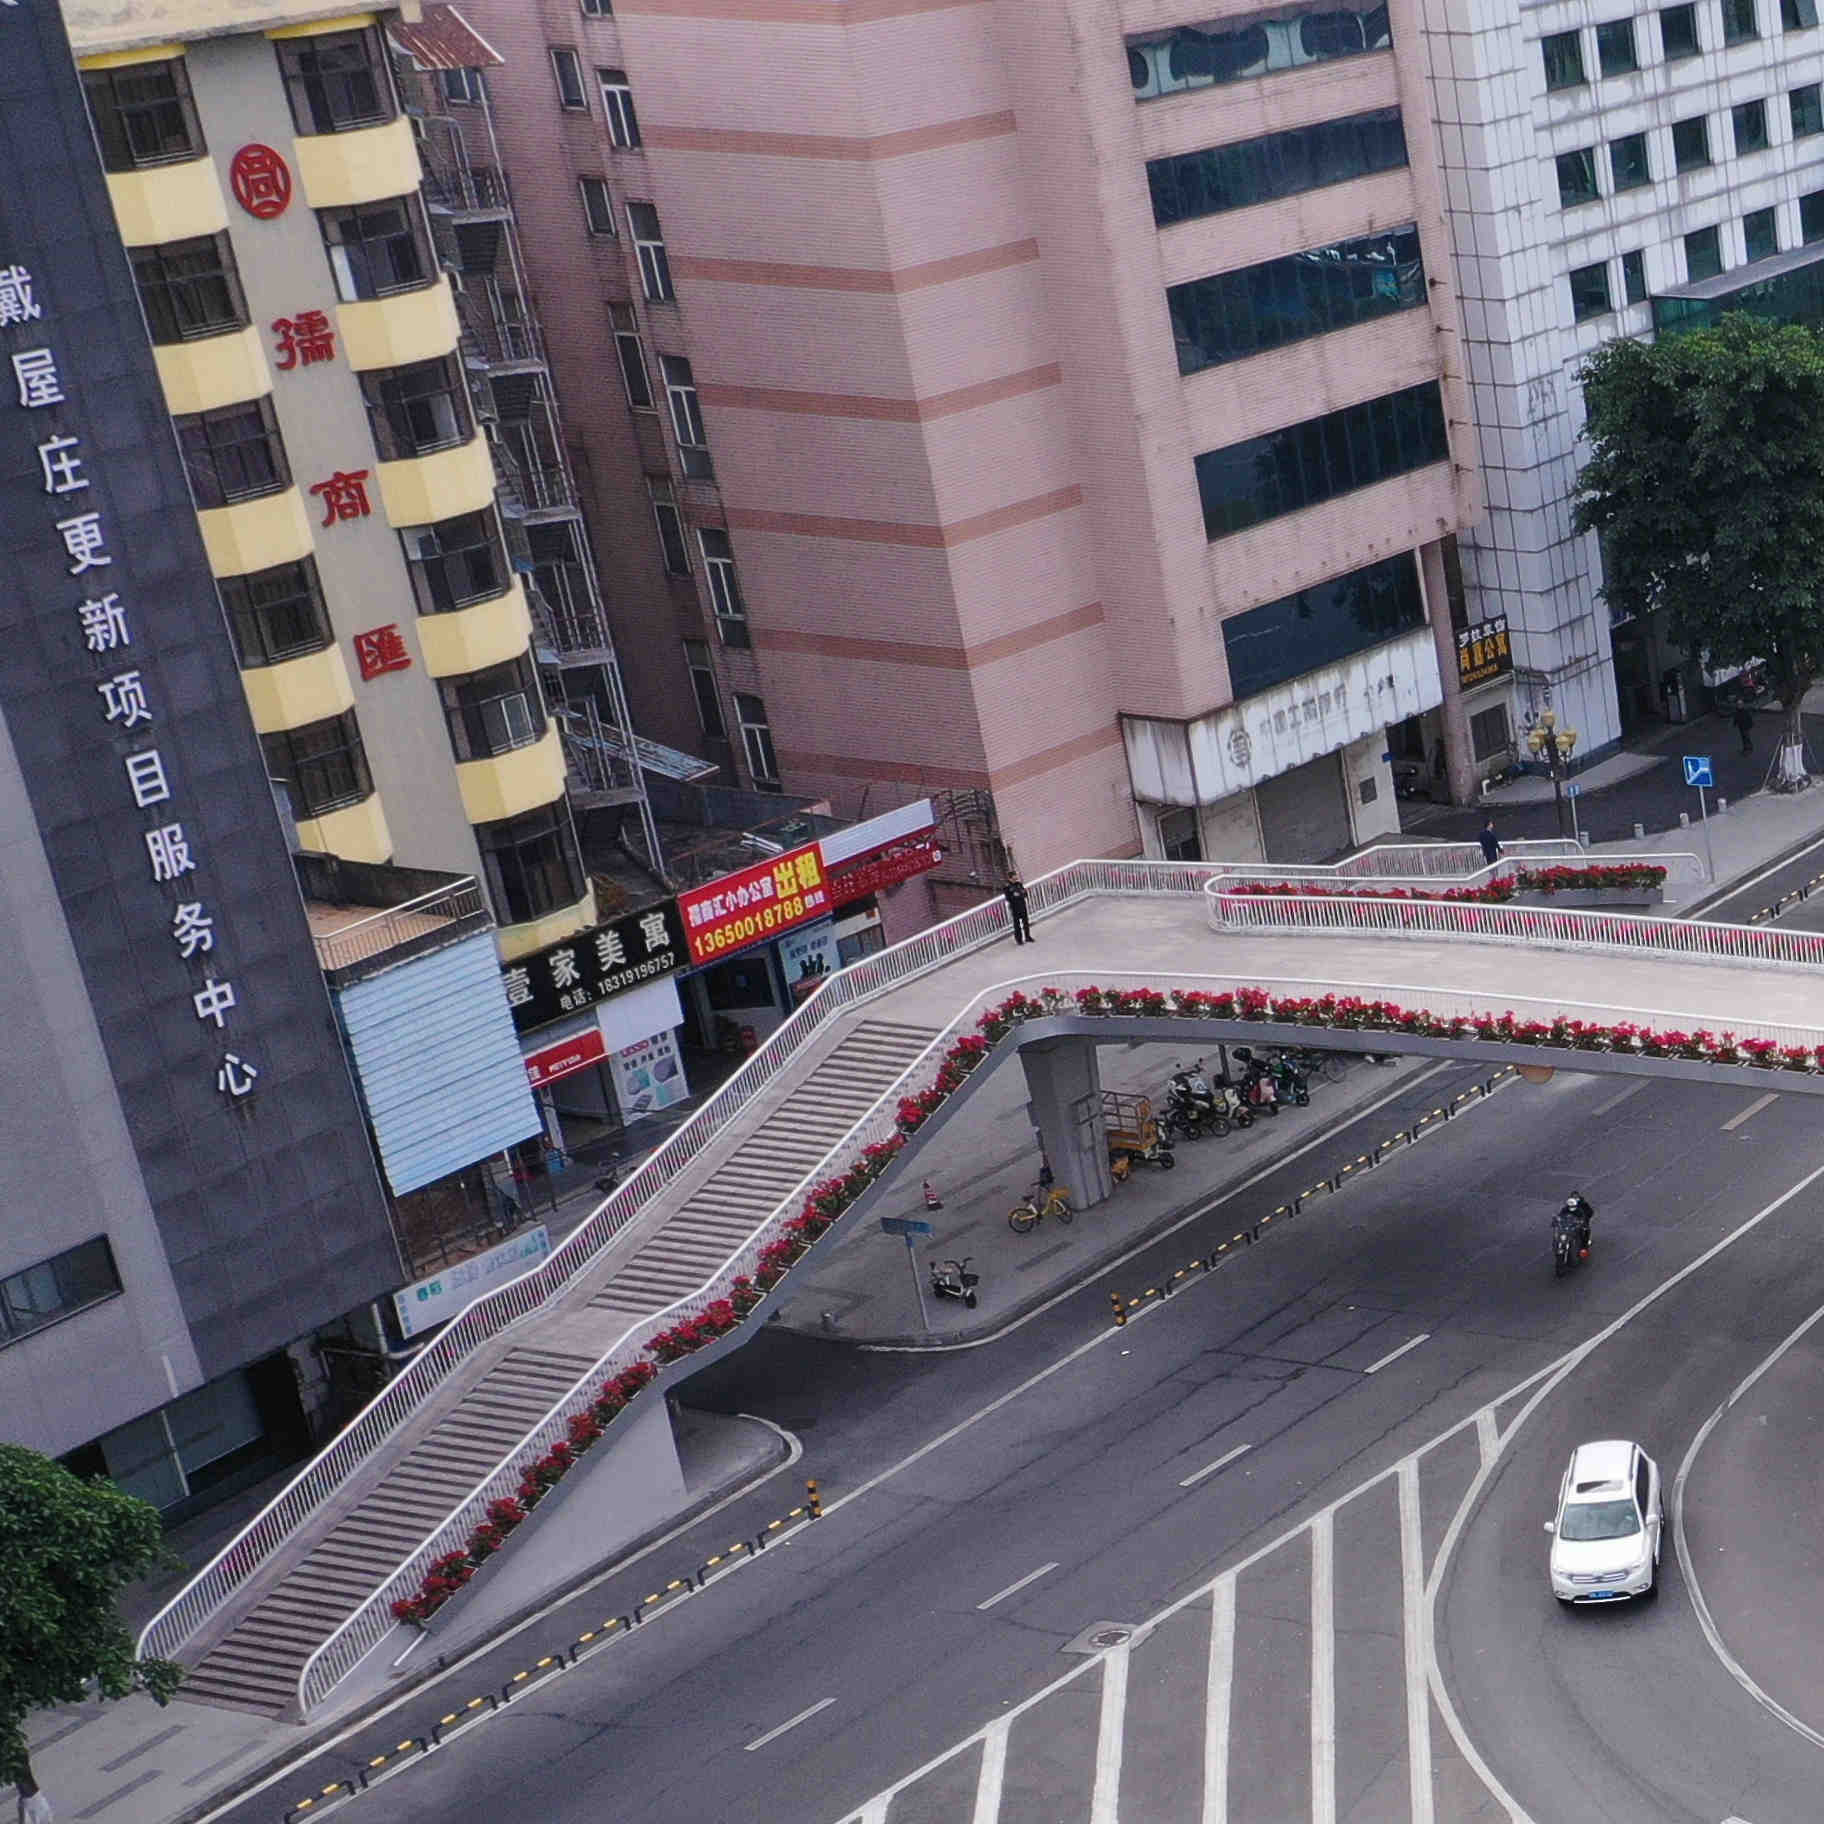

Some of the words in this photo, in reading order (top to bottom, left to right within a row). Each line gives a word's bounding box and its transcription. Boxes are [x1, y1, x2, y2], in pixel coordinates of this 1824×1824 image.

[0, 264, 257, 1096] 戴屋庄更新项目服务中心
[772, 851, 821, 900] 出租
[503, 912, 671, 1007] 壹家美寓
[693, 896, 804, 957] 13650018788
